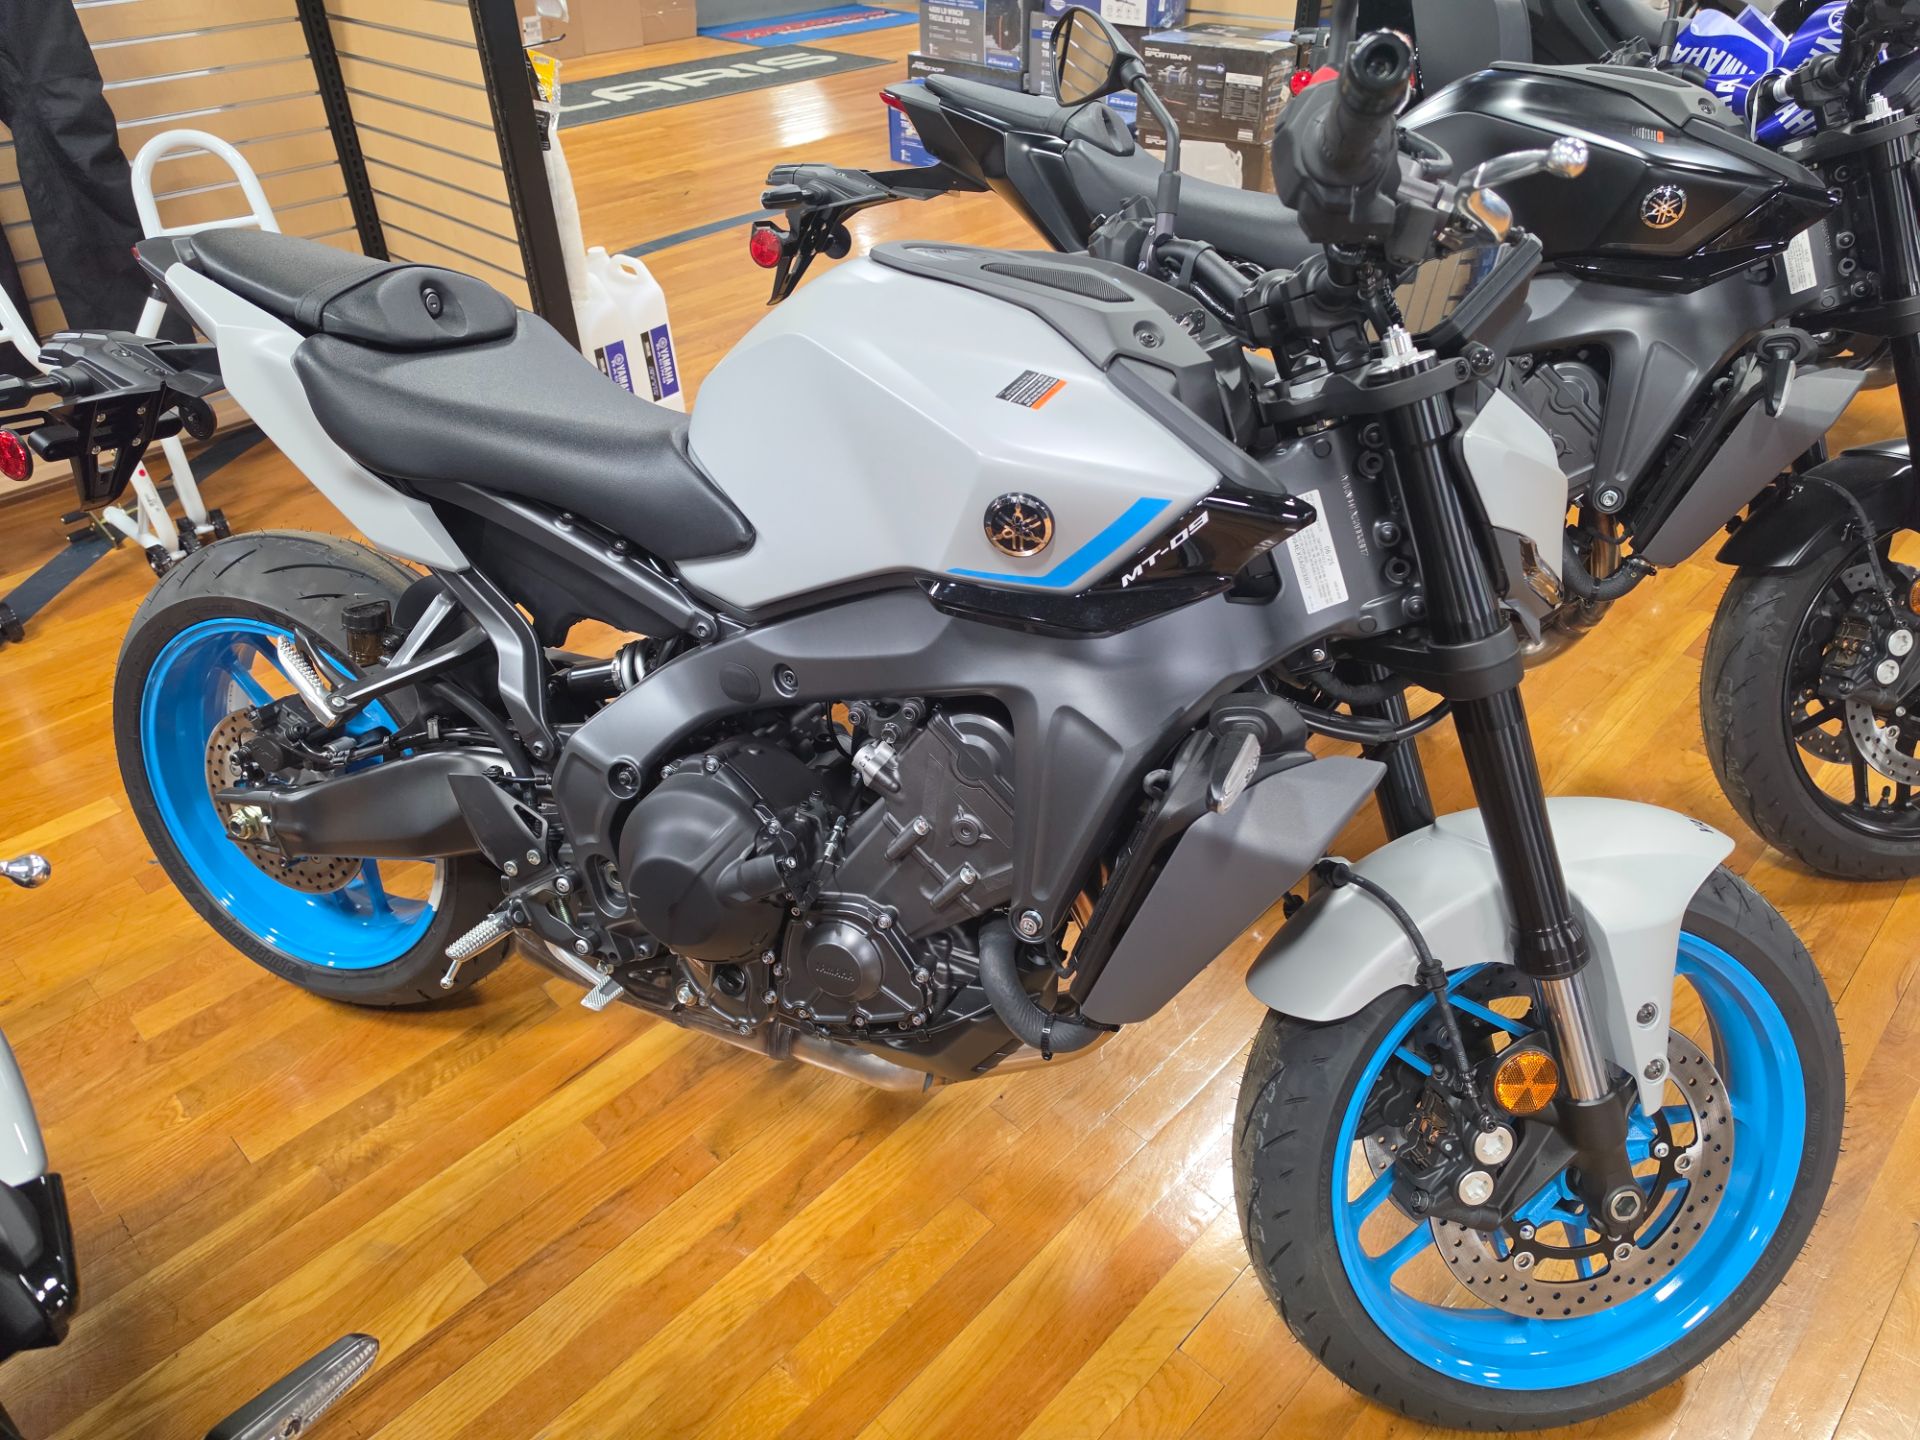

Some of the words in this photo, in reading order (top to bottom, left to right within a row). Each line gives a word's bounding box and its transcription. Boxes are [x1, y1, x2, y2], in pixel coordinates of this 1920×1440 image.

[558, 52, 838, 112] LARIS
[616, 363, 630, 391] YAMA
[660, 347, 675, 385] YAMAHA
[1121, 510, 1209, 588] MT-09
